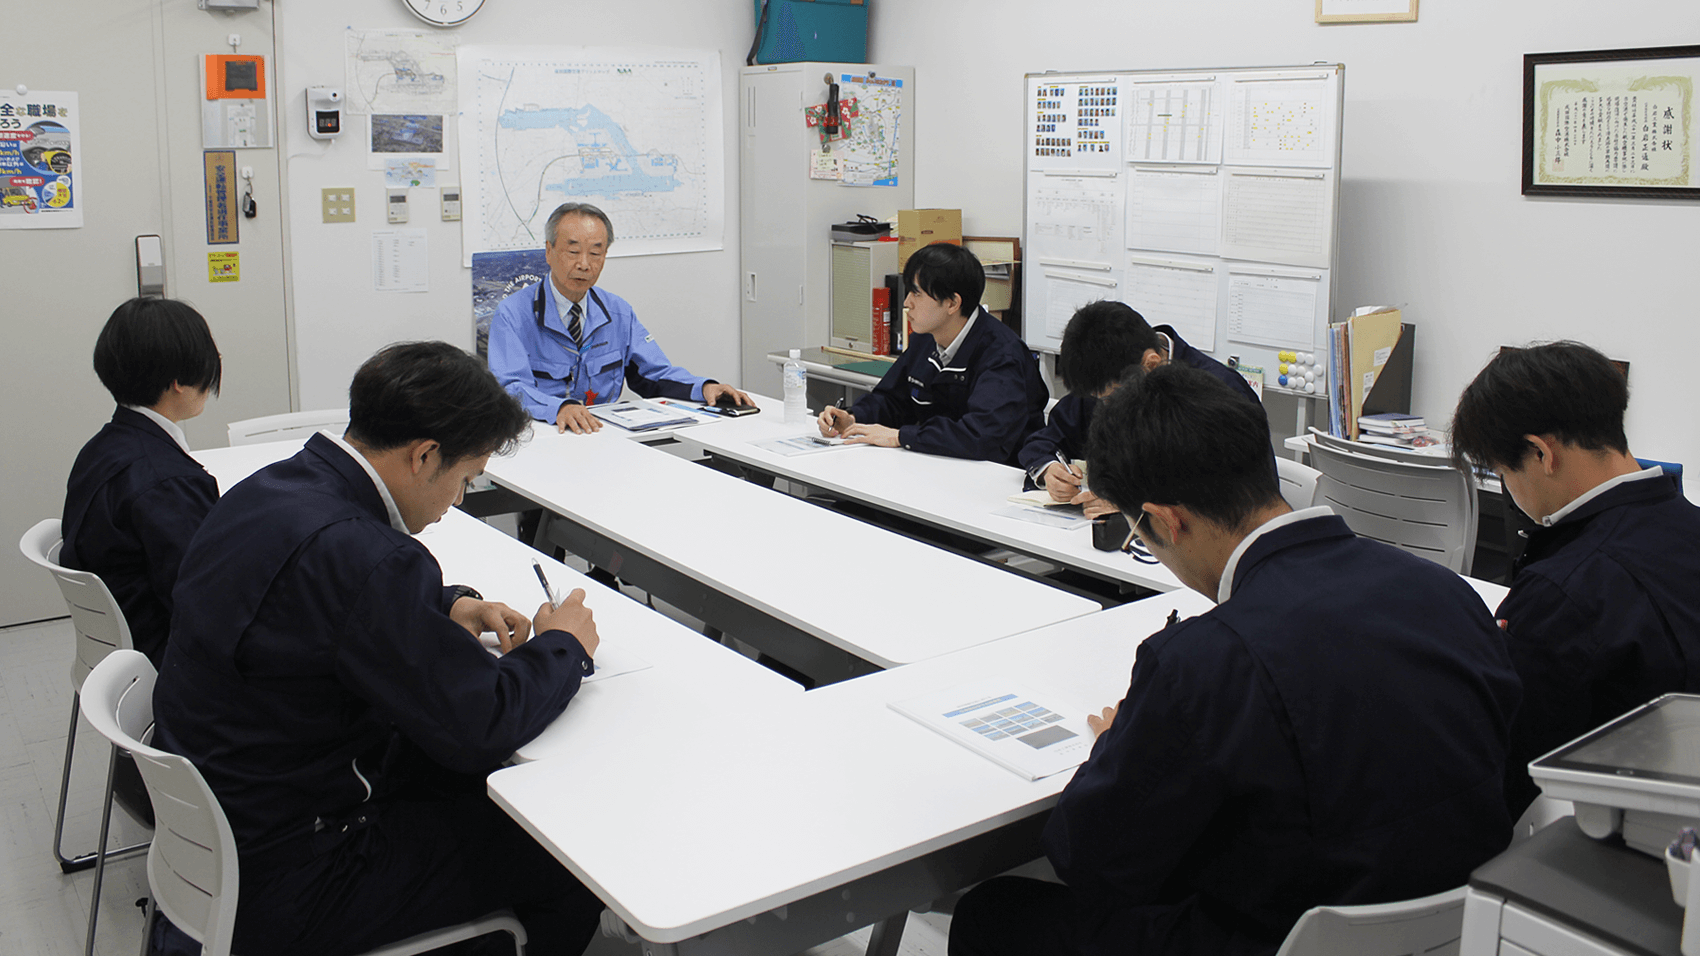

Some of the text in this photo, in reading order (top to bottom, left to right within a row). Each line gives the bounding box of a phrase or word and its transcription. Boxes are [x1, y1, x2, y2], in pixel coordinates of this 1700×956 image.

[440, 4, 447, 15] 6
[457, 1, 463, 12] 5
[1662, 106, 1674, 151] 感謝状
[504, 280, 515, 293] THE
